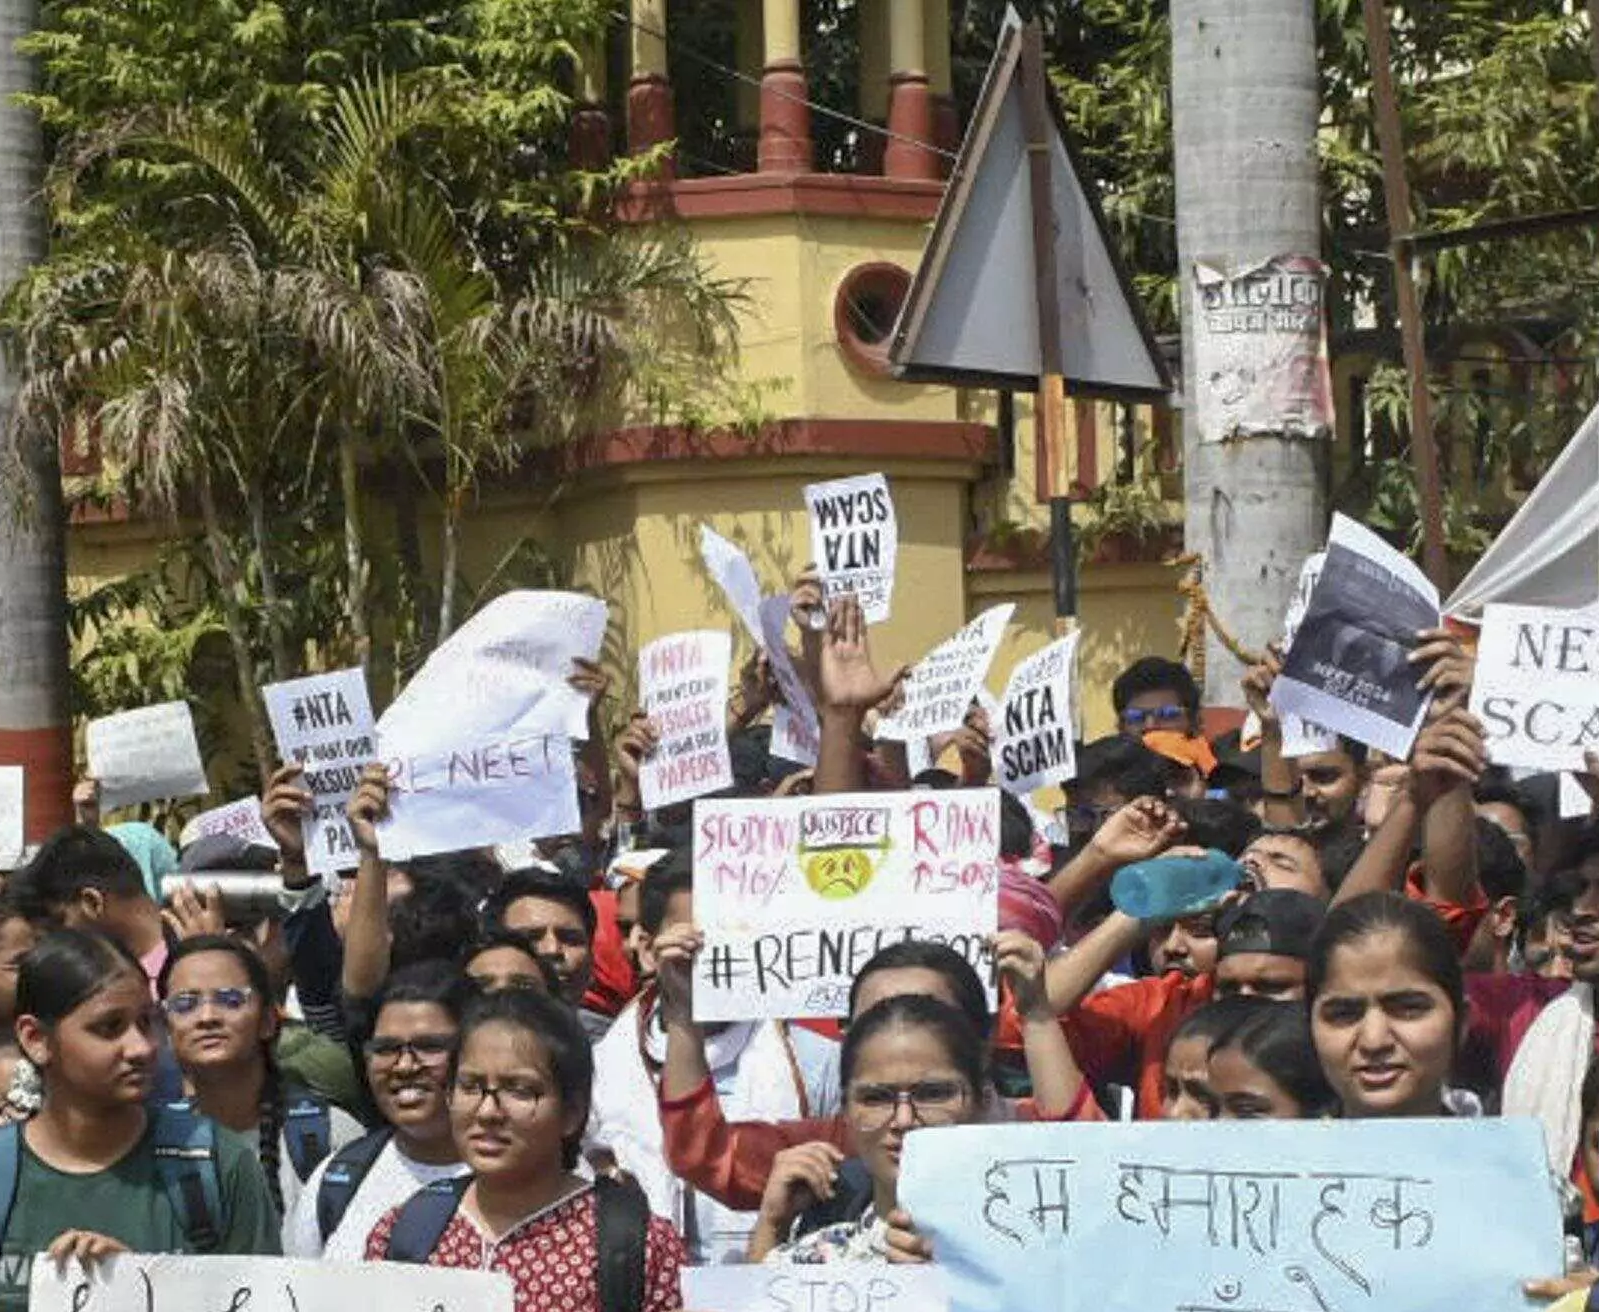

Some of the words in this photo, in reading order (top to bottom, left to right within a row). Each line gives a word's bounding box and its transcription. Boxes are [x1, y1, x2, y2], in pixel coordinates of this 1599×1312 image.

[813, 487, 889, 531] SCAM
[824, 529, 881, 572] NTA
[291, 690, 353, 732] #NTA
[1005, 684, 1057, 735] NTA
[448, 732, 553, 787] NEET
[1002, 728, 1069, 783] SCAM
[304, 766, 363, 796] RESULT
[982, 1158, 1077, 1249] हम
[1115, 1162, 1300, 1257] हमारा
[1308, 1172, 1435, 1297] हक
